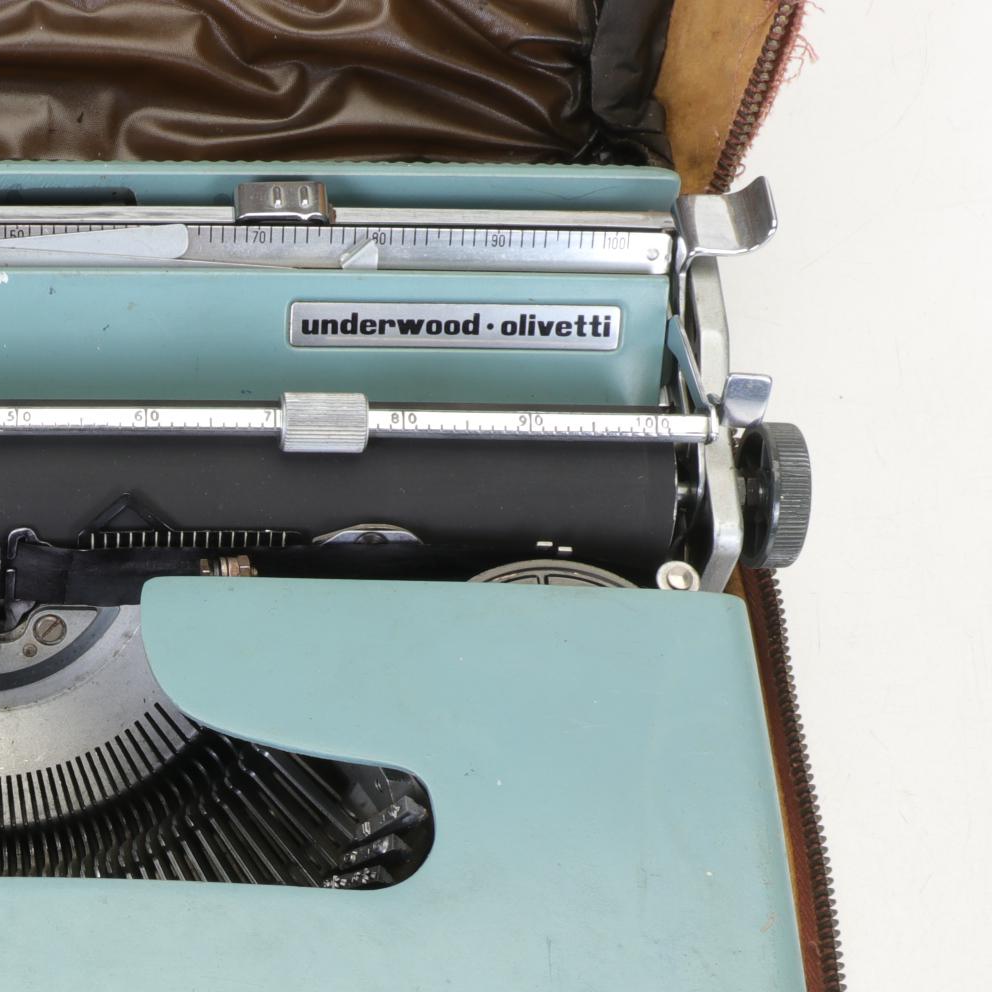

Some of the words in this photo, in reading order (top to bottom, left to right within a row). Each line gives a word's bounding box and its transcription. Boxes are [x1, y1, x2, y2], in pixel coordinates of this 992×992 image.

[253, 231, 266, 243] 70
[491, 235, 506, 247] 90
[608, 237, 626, 249] 100
[301, 312, 480, 336] underwood
[500, 314, 612, 338] olivetti
